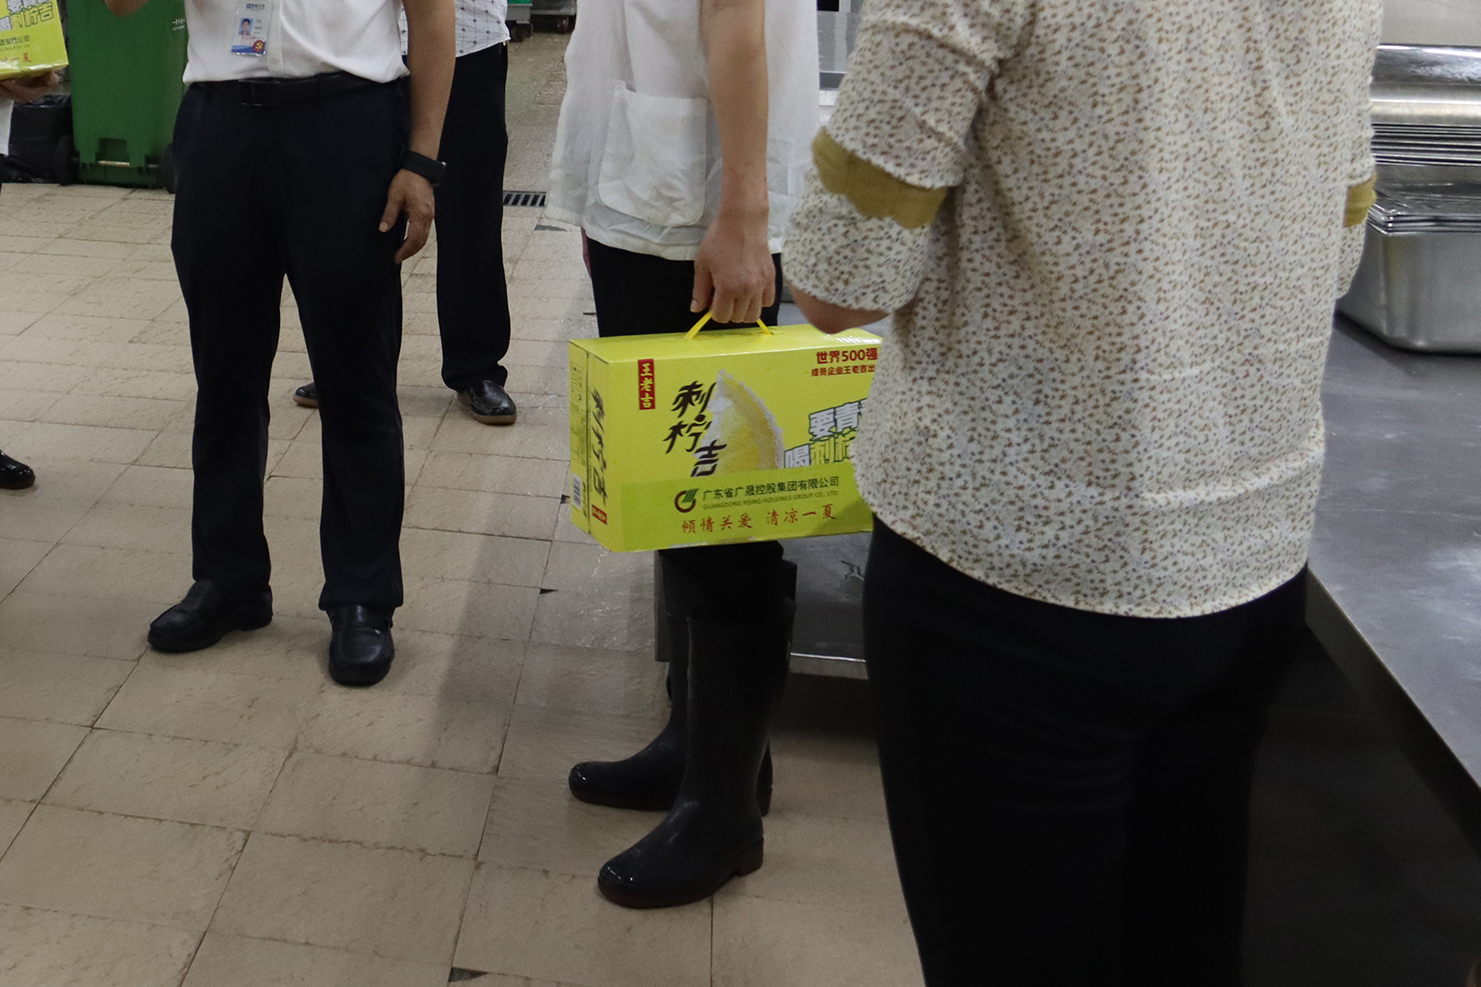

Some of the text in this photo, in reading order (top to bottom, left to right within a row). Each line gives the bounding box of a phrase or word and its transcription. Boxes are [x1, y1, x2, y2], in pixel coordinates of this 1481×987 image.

[811, 364, 876, 376] 成员企业王老吉出
[816, 347, 878, 364] 世界500强
[639, 361, 654, 409] 王老吉
[662, 381, 727, 477] 刺柠吉
[784, 432, 857, 469] 喝刺柠
[702, 476, 839, 501] 广东省广晟控股集团有限公司
[681, 503, 837, 533] 倾情关爱 清凉一夏
